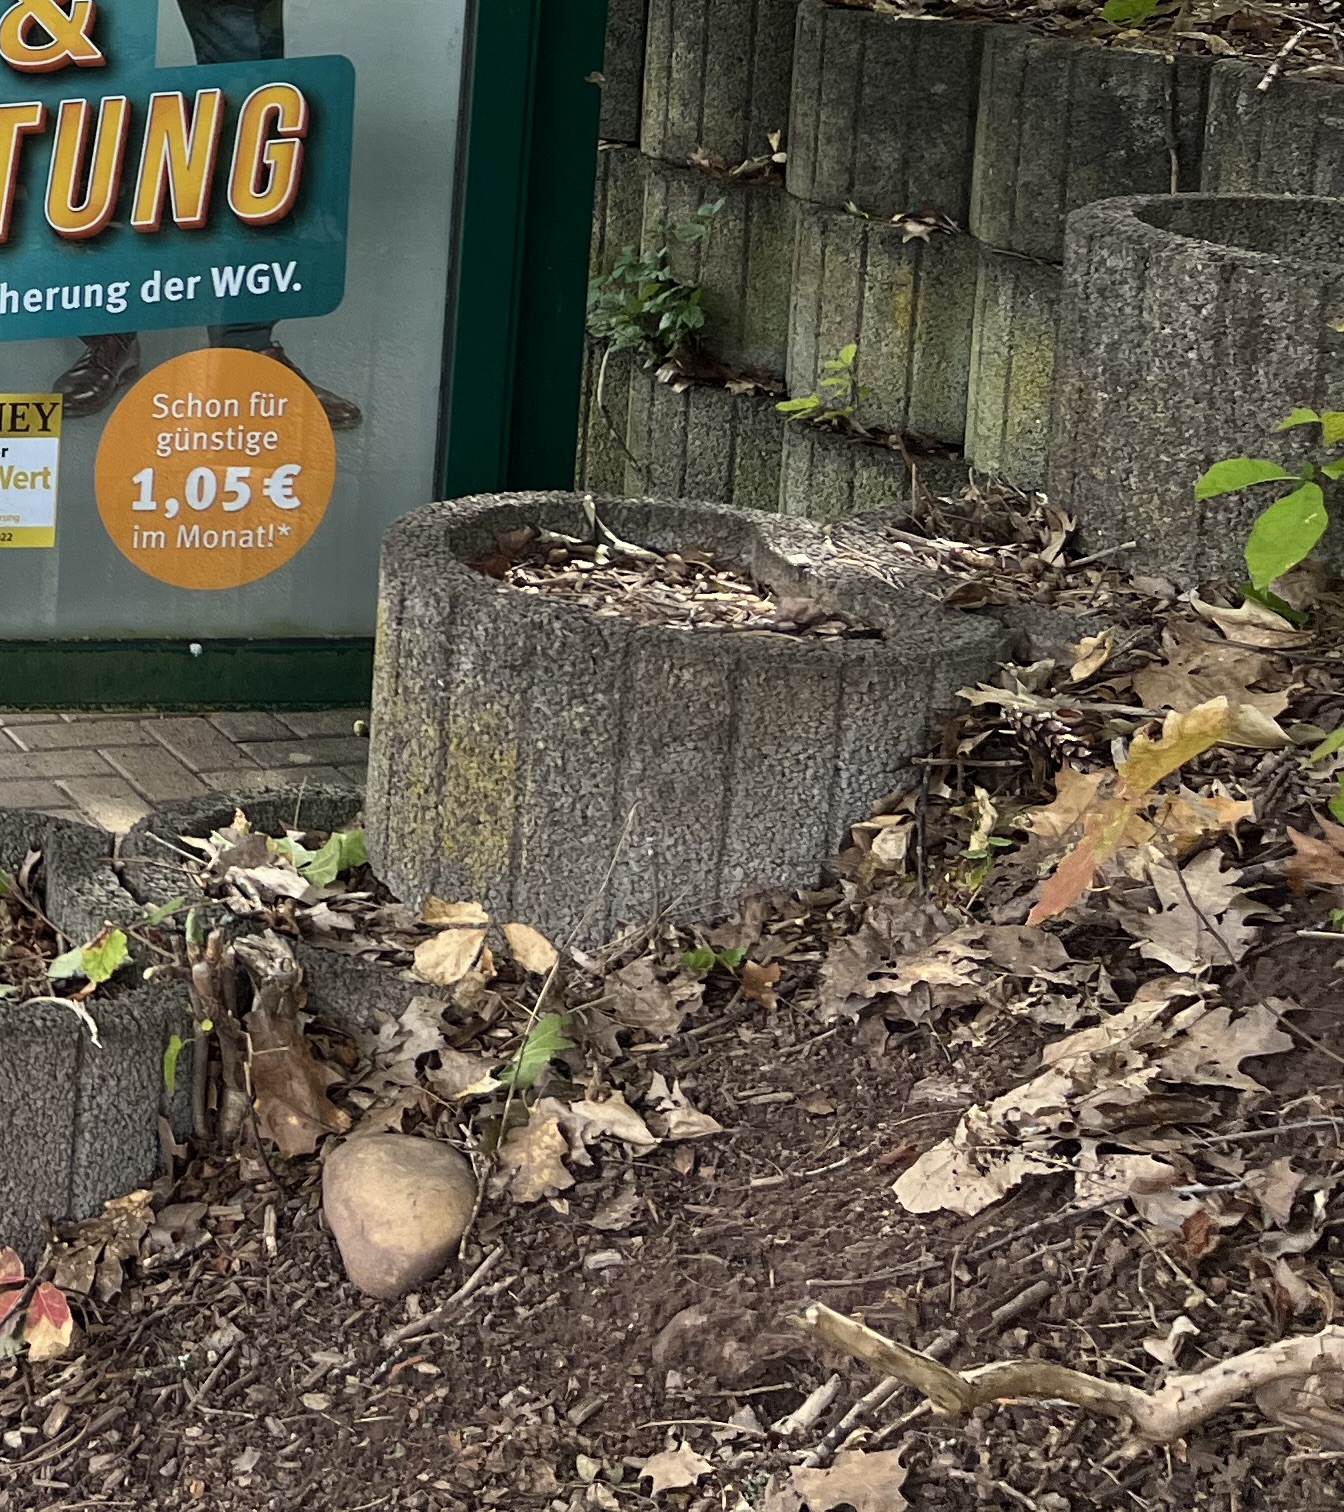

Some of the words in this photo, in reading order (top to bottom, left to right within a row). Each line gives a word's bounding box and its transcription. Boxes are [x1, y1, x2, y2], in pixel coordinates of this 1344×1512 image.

[140, 269, 201, 306] der
[210, 261, 302, 303] WGV.
[152, 392, 239, 419] Schon
[250, 391, 288, 417] für
[156, 425, 279, 457] günstige
[131, 466, 252, 519] 1,05
[263, 464, 302, 511] €
[133, 525, 165, 549] im
